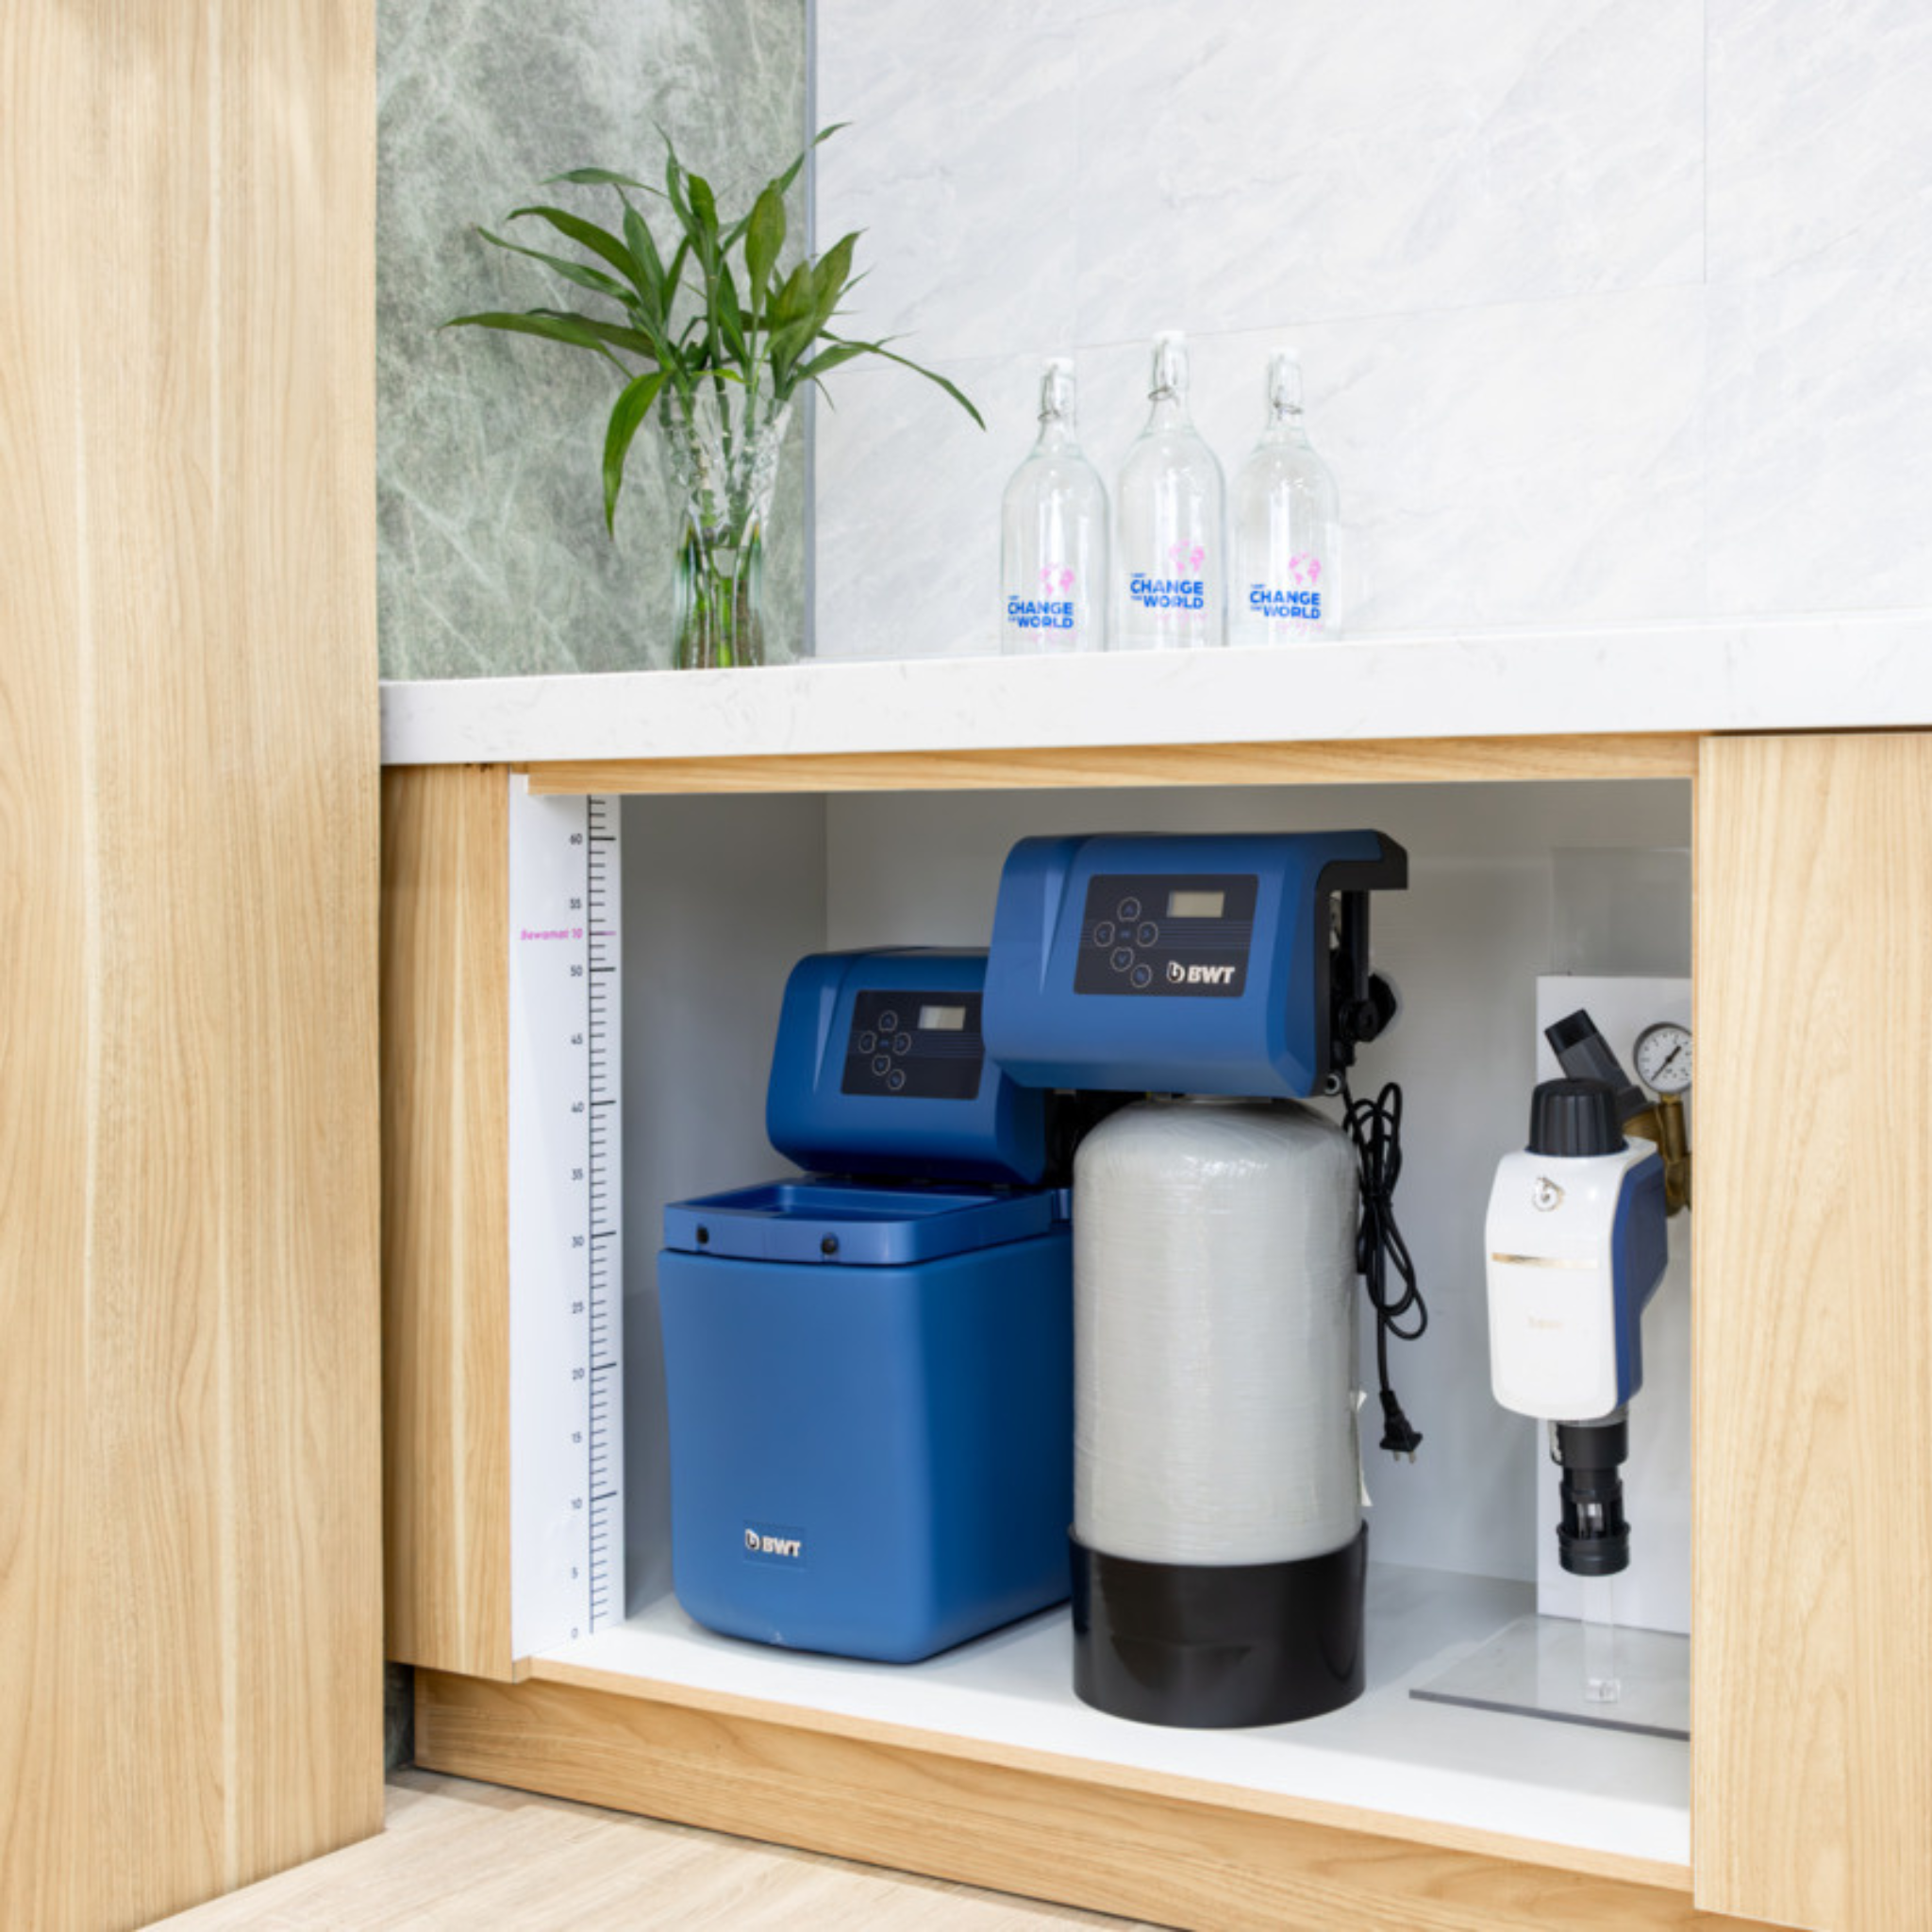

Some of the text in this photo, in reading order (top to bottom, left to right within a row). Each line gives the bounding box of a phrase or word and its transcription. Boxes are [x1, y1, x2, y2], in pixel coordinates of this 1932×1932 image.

[1130, 578, 1204, 596] CHANGE
[1142, 595, 1204, 609] WORLD
[1250, 591, 1321, 606] CHANGE
[1008, 600, 1074, 616] CHANGE
[1264, 605, 1322, 619] WORLD
[1017, 615, 1074, 629] WORLD
[570, 899, 582, 910] 55
[571, 927, 584, 940] 10
[570, 965, 583, 977] 50
[1188, 965, 1236, 984] BWT
[571, 1034, 583, 1045] 45
[572, 1101, 585, 1113] 40
[572, 1367, 585, 1381] 20
[572, 1431, 582, 1443] 15
[571, 1497, 583, 1509] 10
[762, 1536, 802, 1557] BWT
